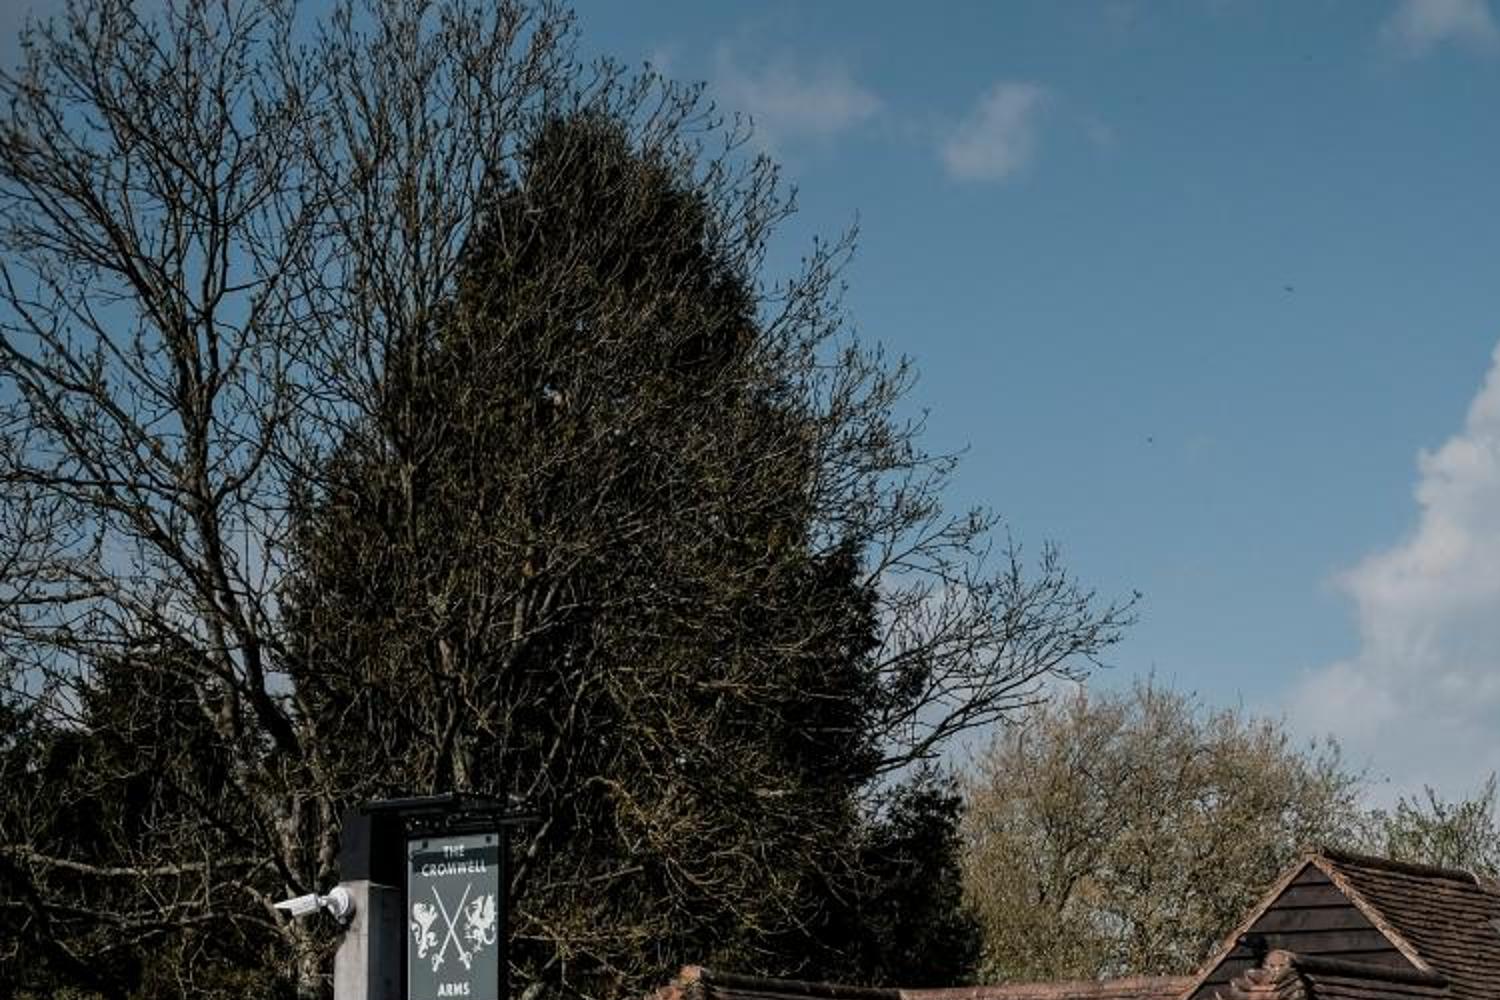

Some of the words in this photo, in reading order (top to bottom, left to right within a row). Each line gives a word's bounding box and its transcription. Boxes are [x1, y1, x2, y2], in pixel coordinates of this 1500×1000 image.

[442, 844, 465, 858] THE
[421, 859, 487, 877] CROMWELL
[437, 981, 470, 997] ARMS
